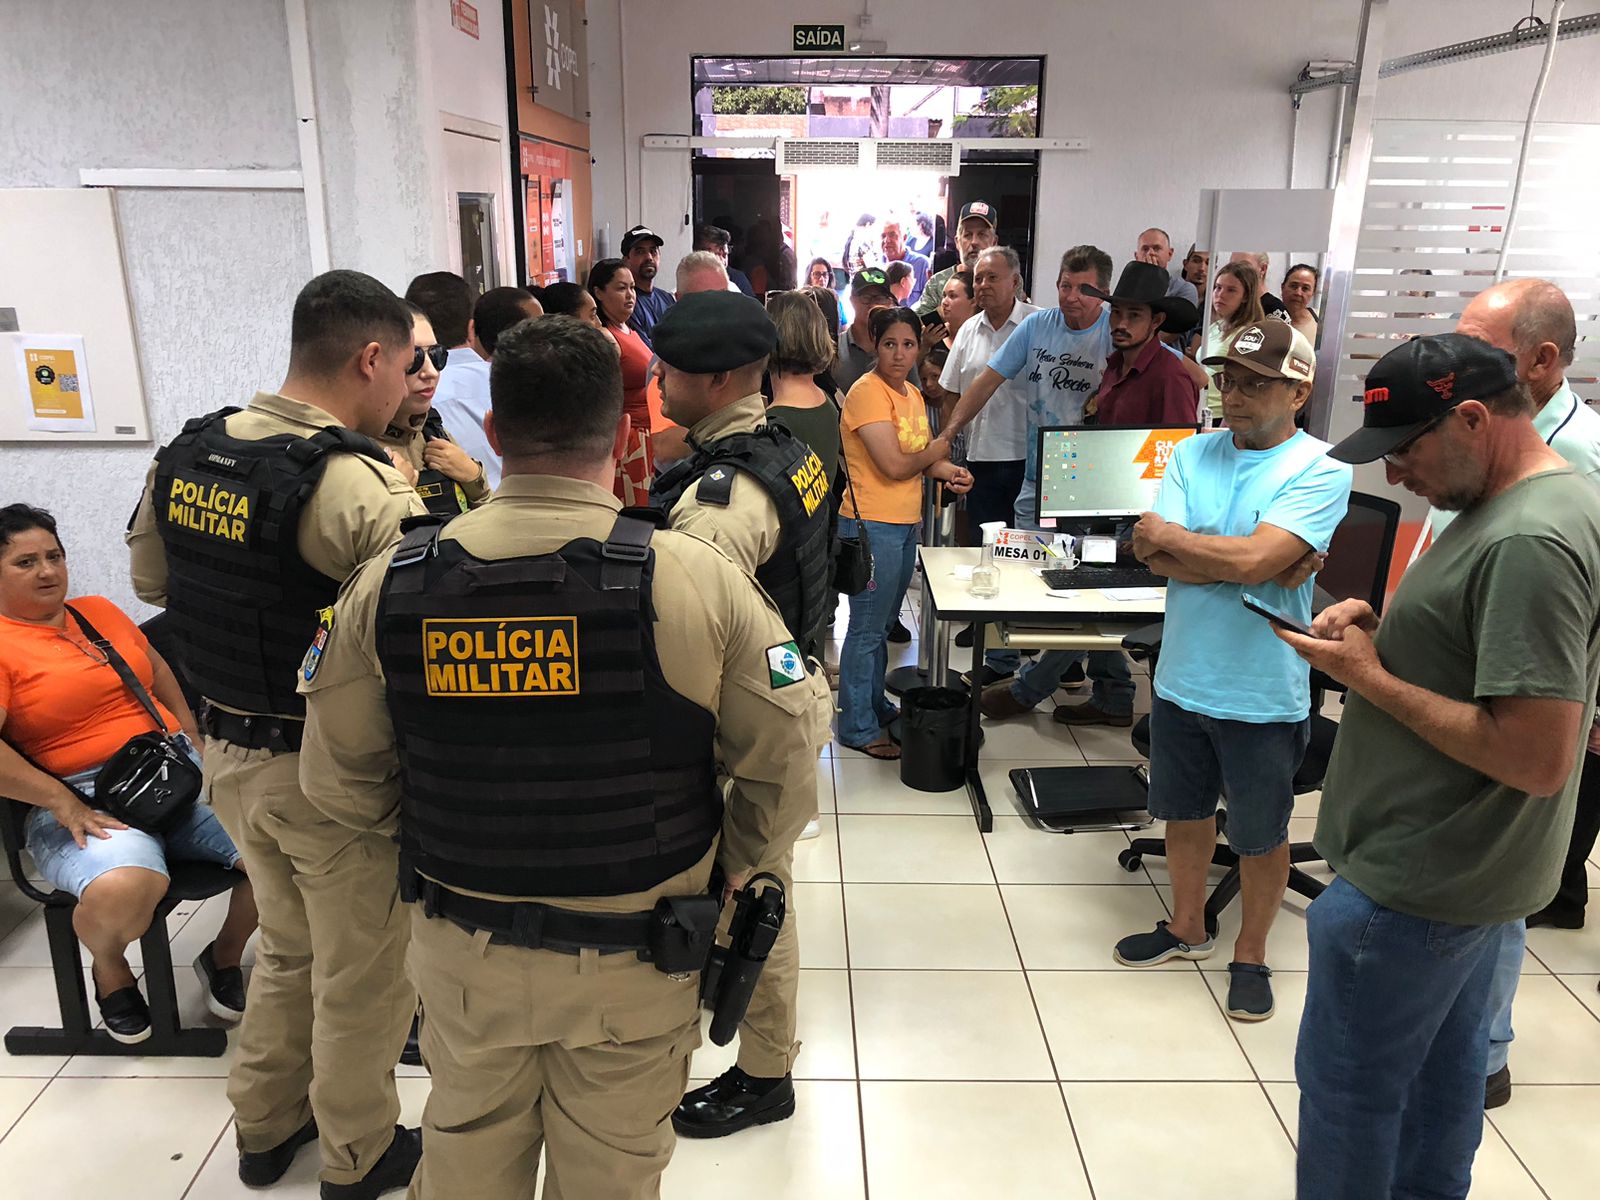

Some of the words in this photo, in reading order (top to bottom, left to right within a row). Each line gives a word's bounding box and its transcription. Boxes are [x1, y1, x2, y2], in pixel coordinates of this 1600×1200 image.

[795, 26, 842, 46] SAÍDA
[1028, 364, 1043, 383] do
[1049, 366, 1091, 392] Rocio
[791, 452, 824, 496] POLÍCIA
[170, 478, 249, 519] POLÍCIA
[802, 470, 829, 518] MILITAR
[168, 501, 245, 543] MILITAR
[1010, 533, 1032, 541] COPEL
[994, 546, 1029, 560] MESA
[1033, 550, 1047, 561] 01
[427, 622, 572, 660] POLÍCIA
[428, 662, 574, 692] MILITAR
